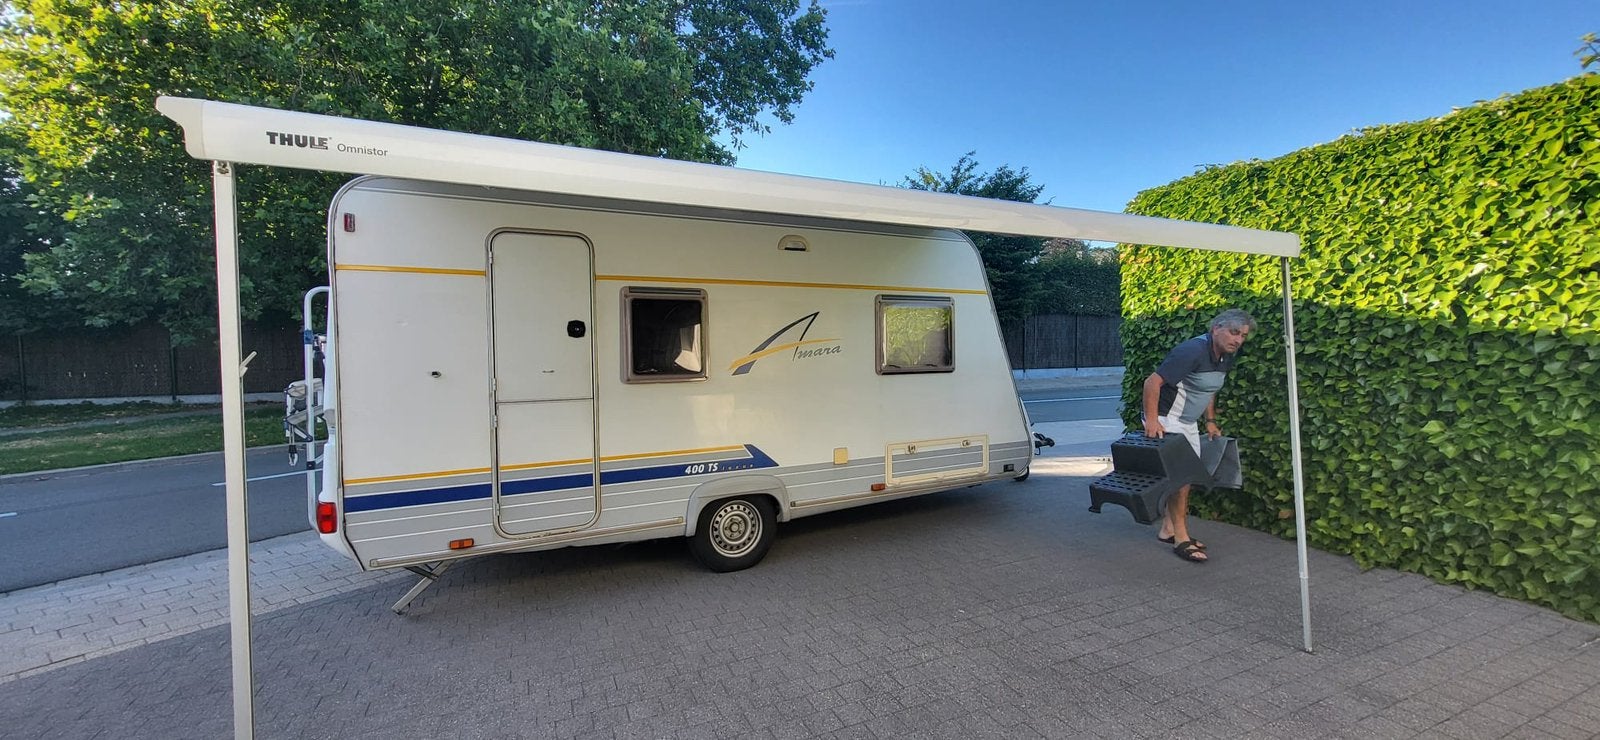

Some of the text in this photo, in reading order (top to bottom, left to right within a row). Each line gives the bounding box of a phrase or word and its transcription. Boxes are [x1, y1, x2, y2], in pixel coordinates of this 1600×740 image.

[266, 131, 389, 157] THULE Omnistor
[729, 311, 842, 376] Amara
[685, 464, 705, 474] 400
[708, 462, 719, 472] TS
